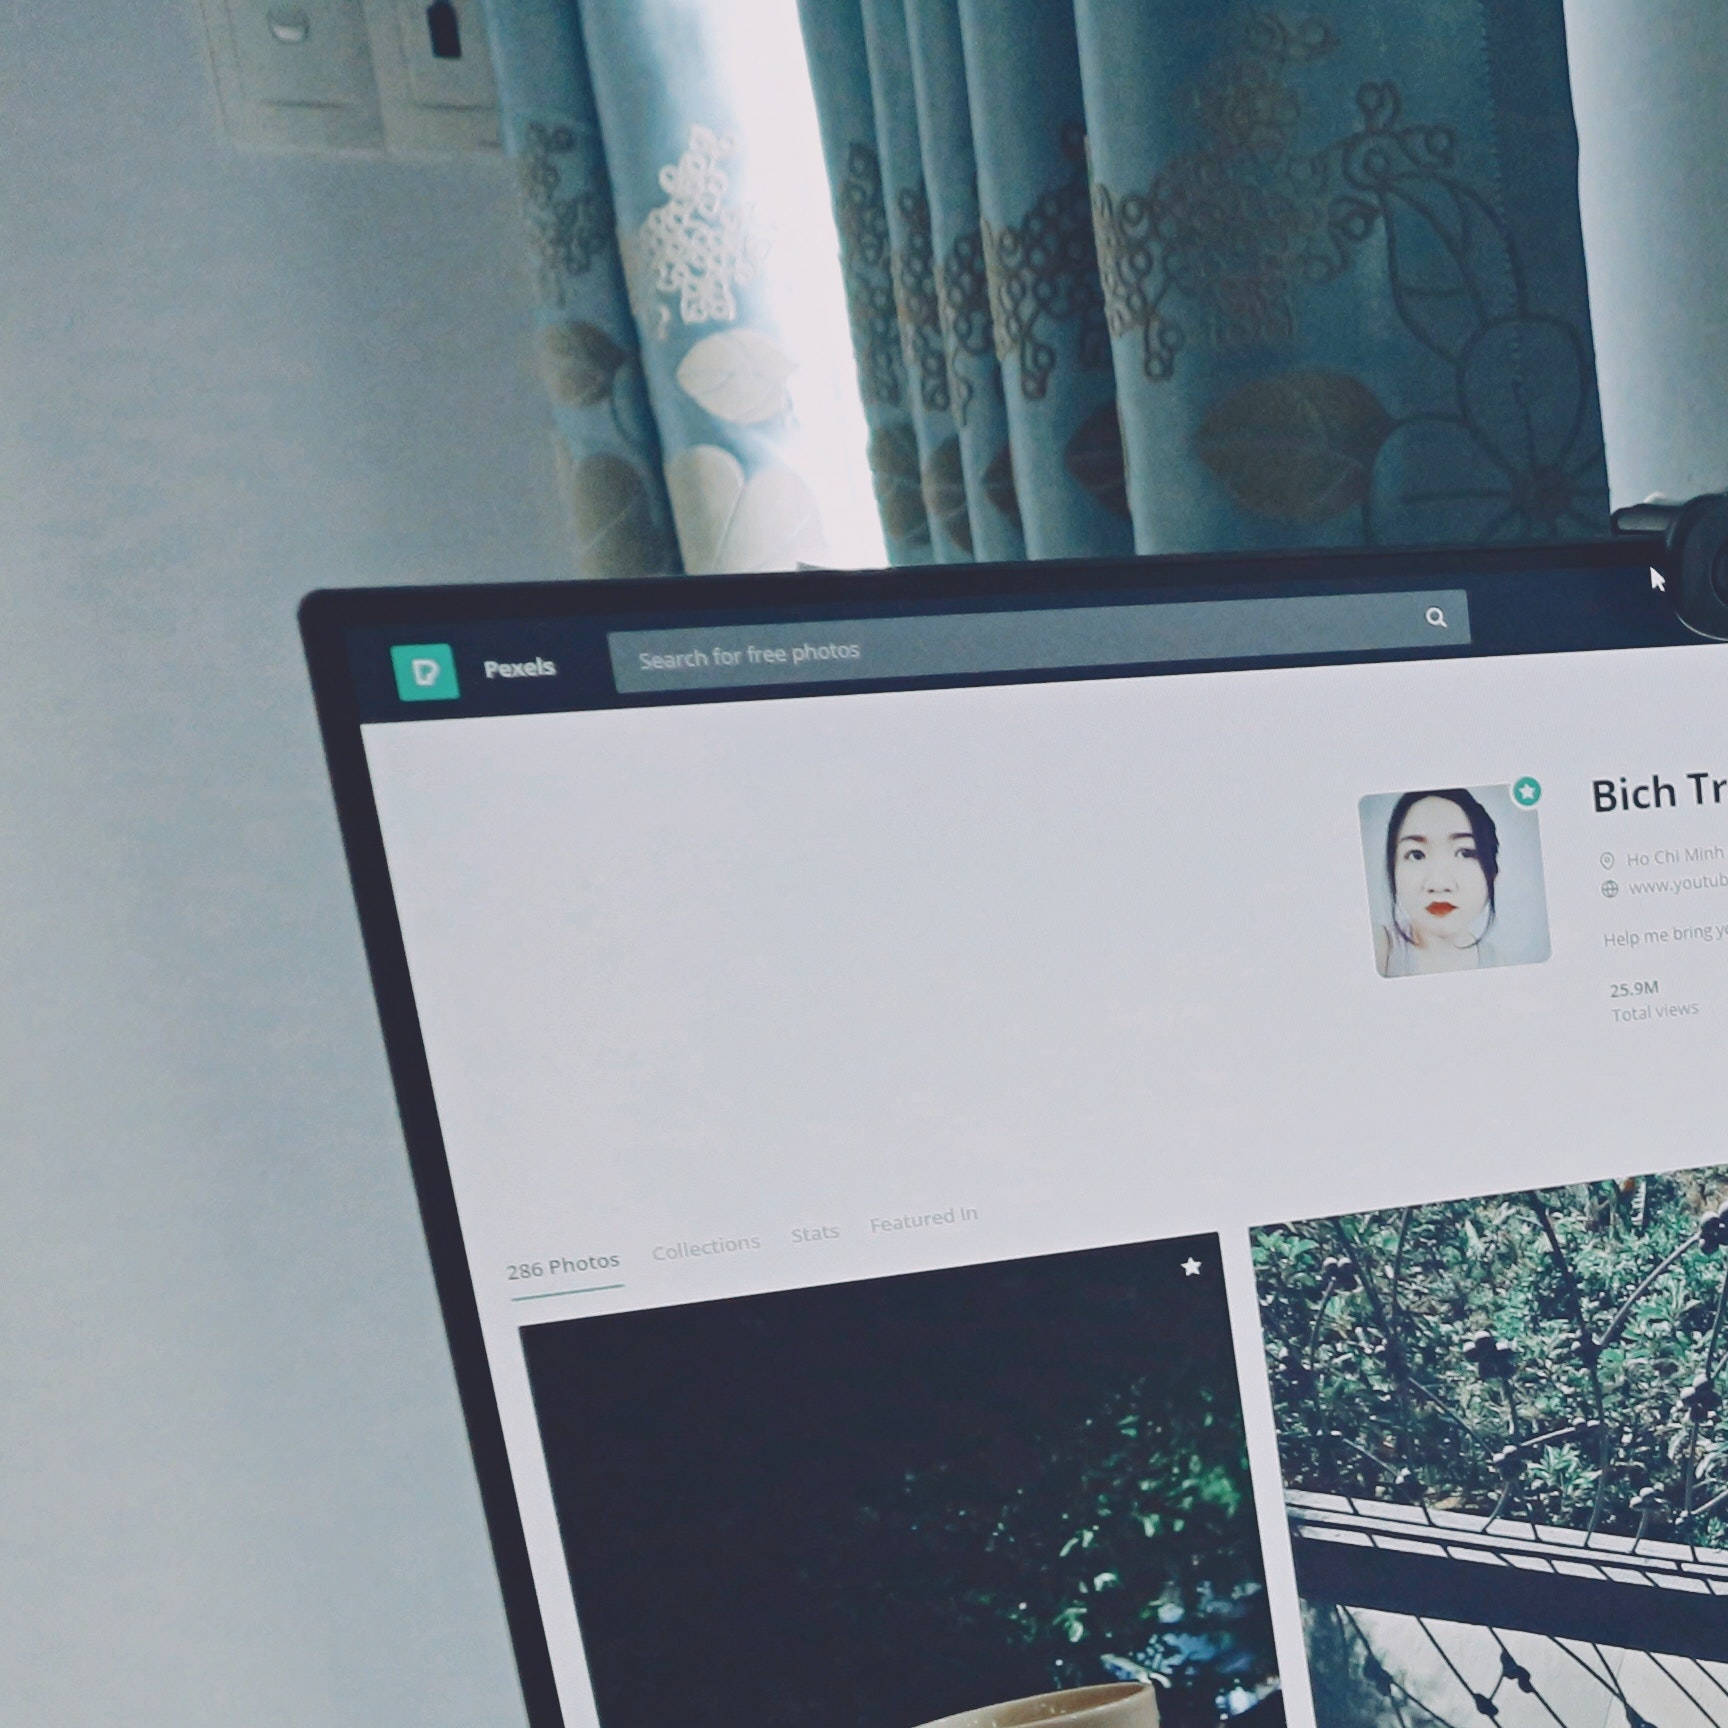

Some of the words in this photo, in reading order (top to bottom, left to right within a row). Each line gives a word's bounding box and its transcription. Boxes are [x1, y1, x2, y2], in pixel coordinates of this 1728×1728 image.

[484, 656, 556, 680] Pexels
[640, 648, 707, 672] Search
[712, 646, 742, 666] for
[747, 643, 787, 664] free
[792, 640, 860, 665] photos
[1593, 774, 1676, 812] Bich
[1627, 852, 1649, 867] Ho
[1685, 846, 1724, 863] Minh
[1604, 932, 1640, 948] Help
[1644, 931, 1668, 943] me
[1673, 924, 1713, 942] bring
[1610, 981, 1659, 998] 25.9M
[1612, 1007, 1651, 1022] Total
[1657, 1002, 1699, 1018] views
[870, 1210, 955, 1234] Featured
[960, 1206, 978, 1220] In
[791, 1224, 839, 1243] Stats
[652, 1233, 760, 1262] Collections
[507, 1261, 543, 1281] 286
[549, 1253, 620, 1275] Photos
